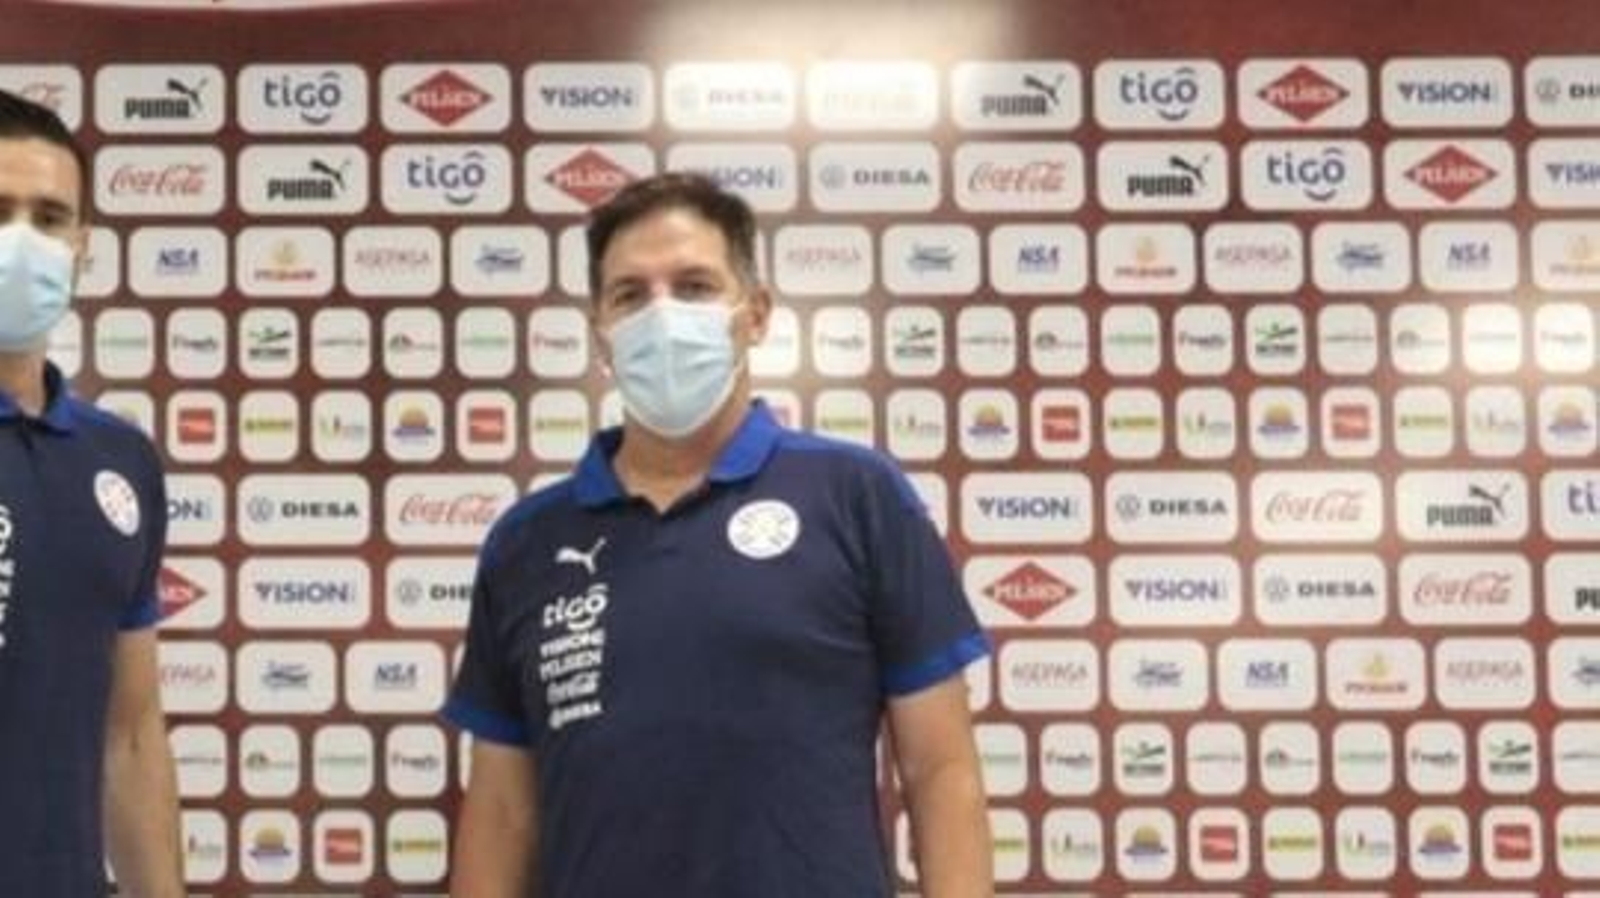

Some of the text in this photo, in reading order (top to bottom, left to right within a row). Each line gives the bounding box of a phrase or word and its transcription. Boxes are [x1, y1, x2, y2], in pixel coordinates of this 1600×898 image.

[540, 87, 632, 108] VISION
[1398, 82, 1490, 103] VISION
[125, 98, 190, 119] PUMA
[981, 95, 1047, 116] PUMA
[854, 169, 930, 184] DIESA
[1128, 175, 1194, 197] PUMA
[268, 178, 334, 200] PUMA
[282, 502, 358, 517] DIESA
[977, 496, 1070, 518] VISION
[1148, 501, 1227, 515] DIESA
[1427, 505, 1493, 526] PUMA
[255, 582, 348, 603] VISION
[430, 585, 471, 600] DIE
[1125, 580, 1218, 601] VISION
[1298, 582, 1375, 597] DIESA
